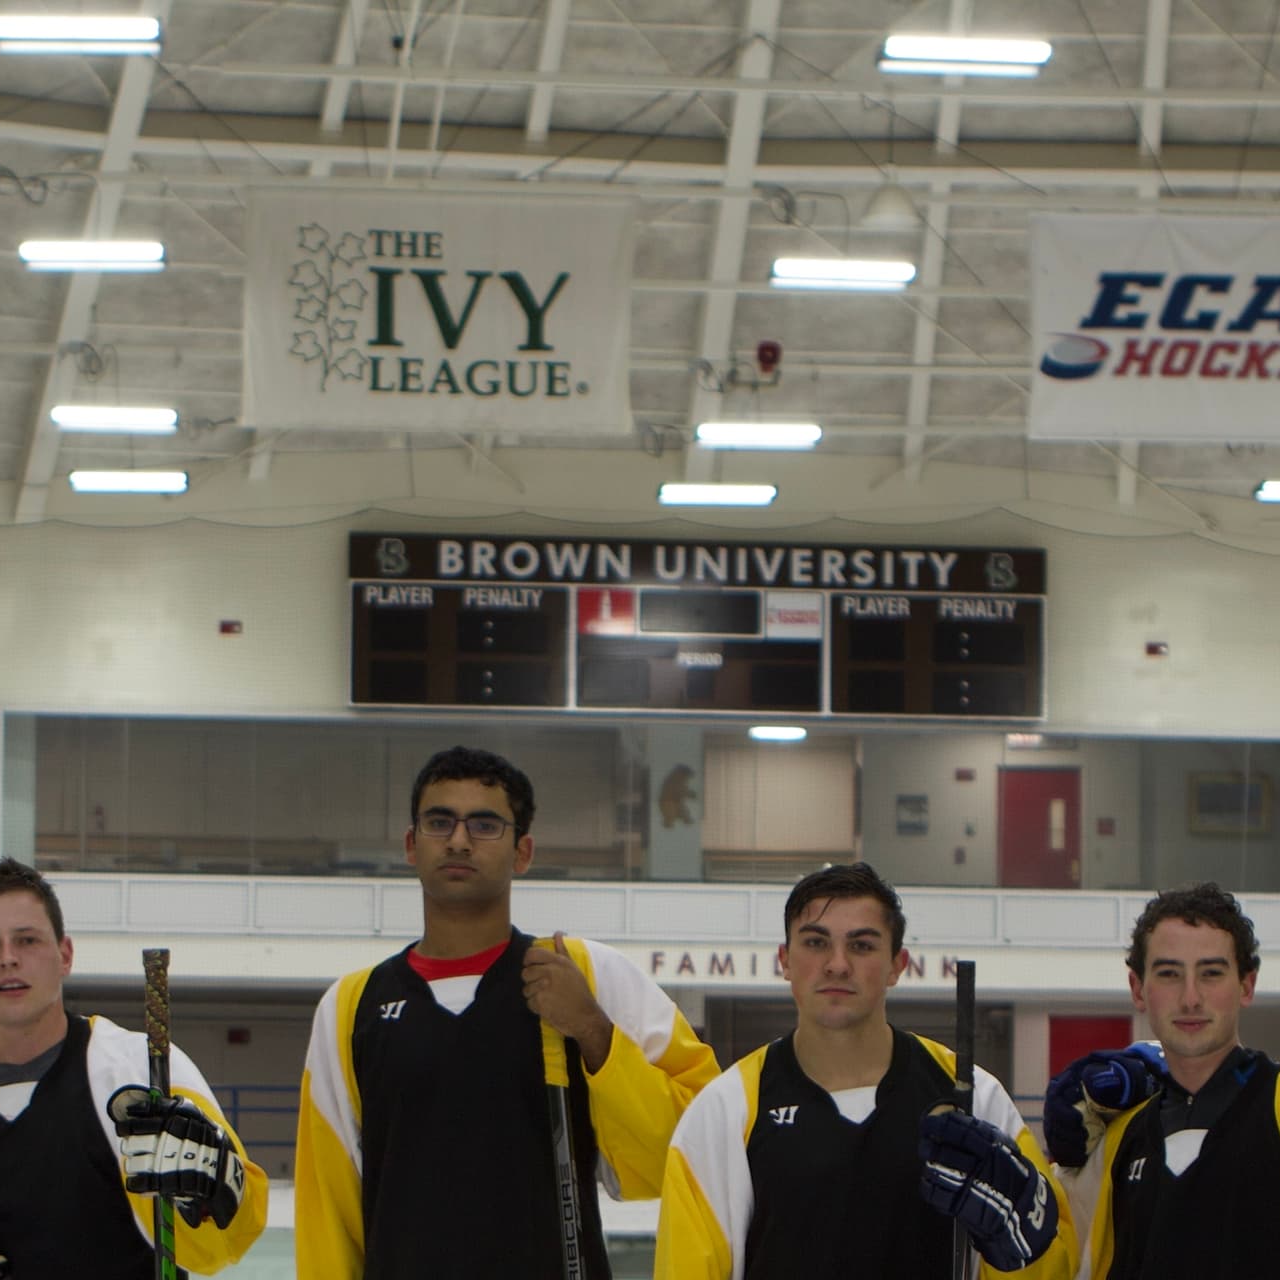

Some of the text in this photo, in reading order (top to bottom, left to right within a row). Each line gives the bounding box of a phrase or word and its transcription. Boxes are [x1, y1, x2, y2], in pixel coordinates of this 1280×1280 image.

[368, 229, 443, 258] THE
[367, 266, 570, 352] IVY
[438, 541, 631, 578] BROWN
[654, 545, 958, 587] UNIVERSITY
[365, 586, 542, 608] PLAYER PENALTY
[842, 596, 910, 616] PLAYER
[940, 599, 1017, 620] PENALTY
[651, 951, 783, 977] FAMIL
